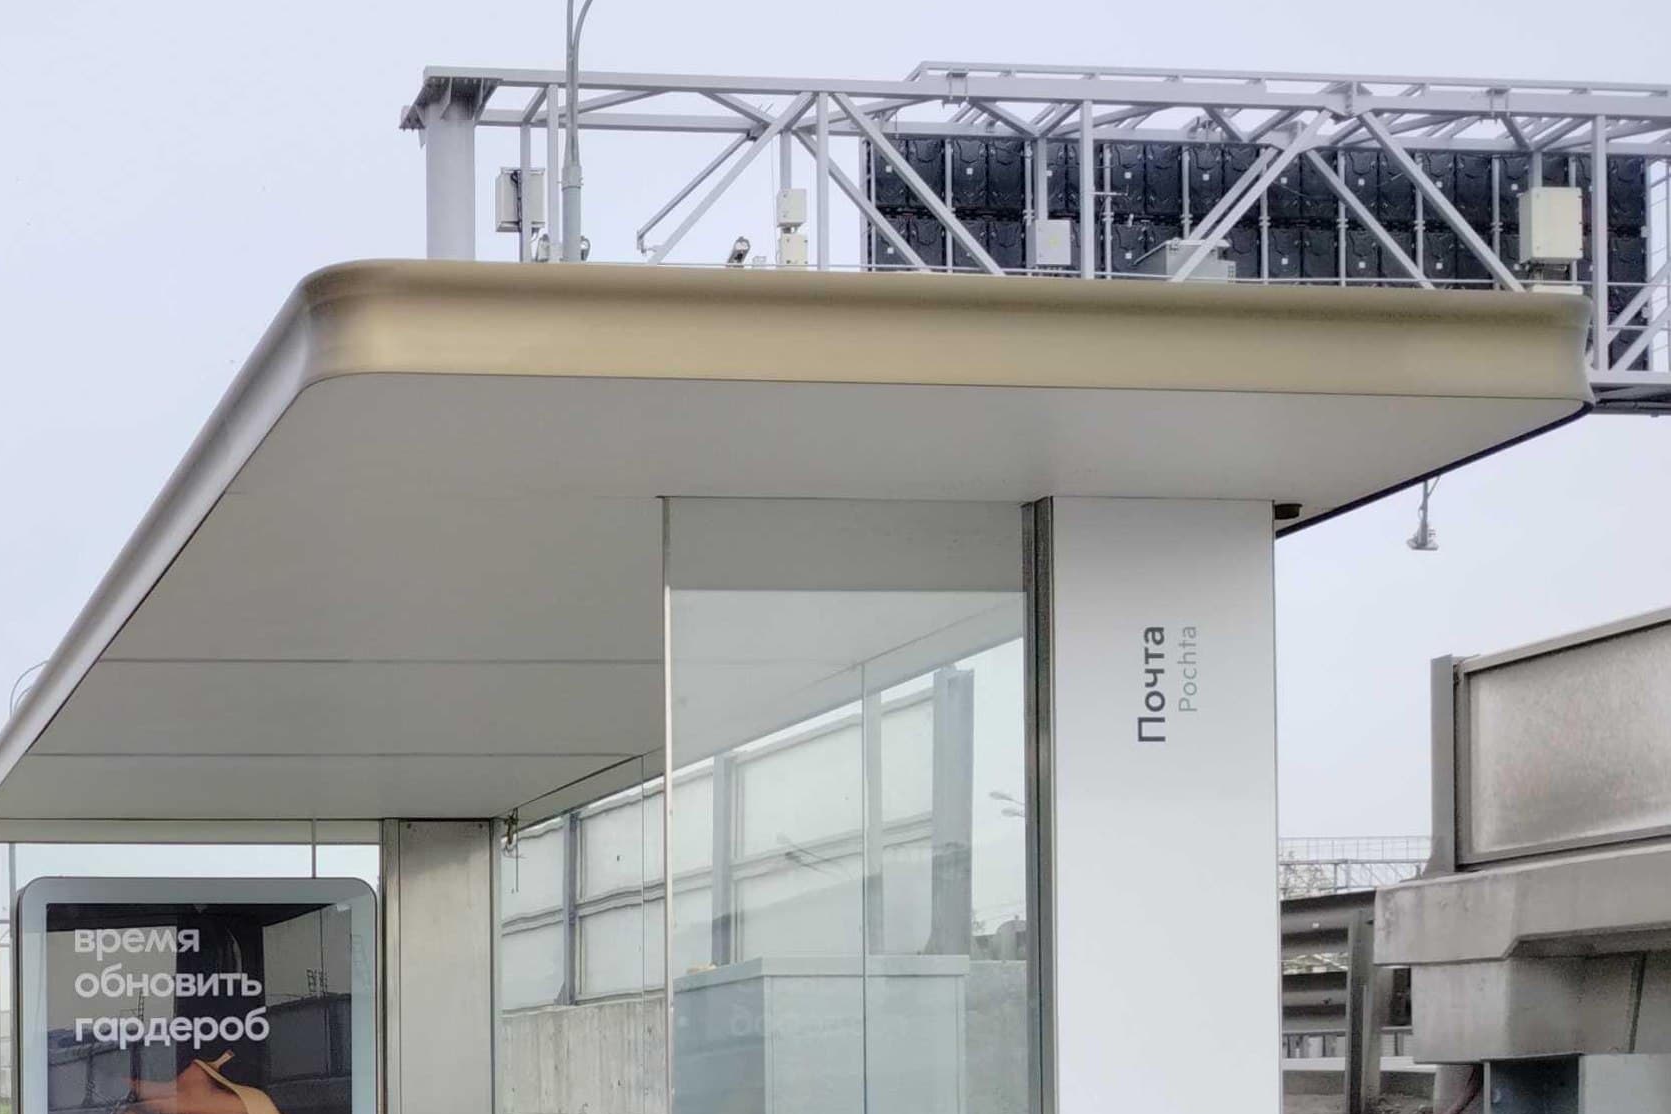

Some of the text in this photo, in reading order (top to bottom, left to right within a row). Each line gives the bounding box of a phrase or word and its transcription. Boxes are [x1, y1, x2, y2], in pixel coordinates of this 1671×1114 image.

[1137, 626, 1166, 742] Почта
[1177, 626, 1198, 712] Pochta
[74, 928, 200, 961] время
[74, 963, 263, 998] обновить
[74, 1006, 270, 1050] гардероб
